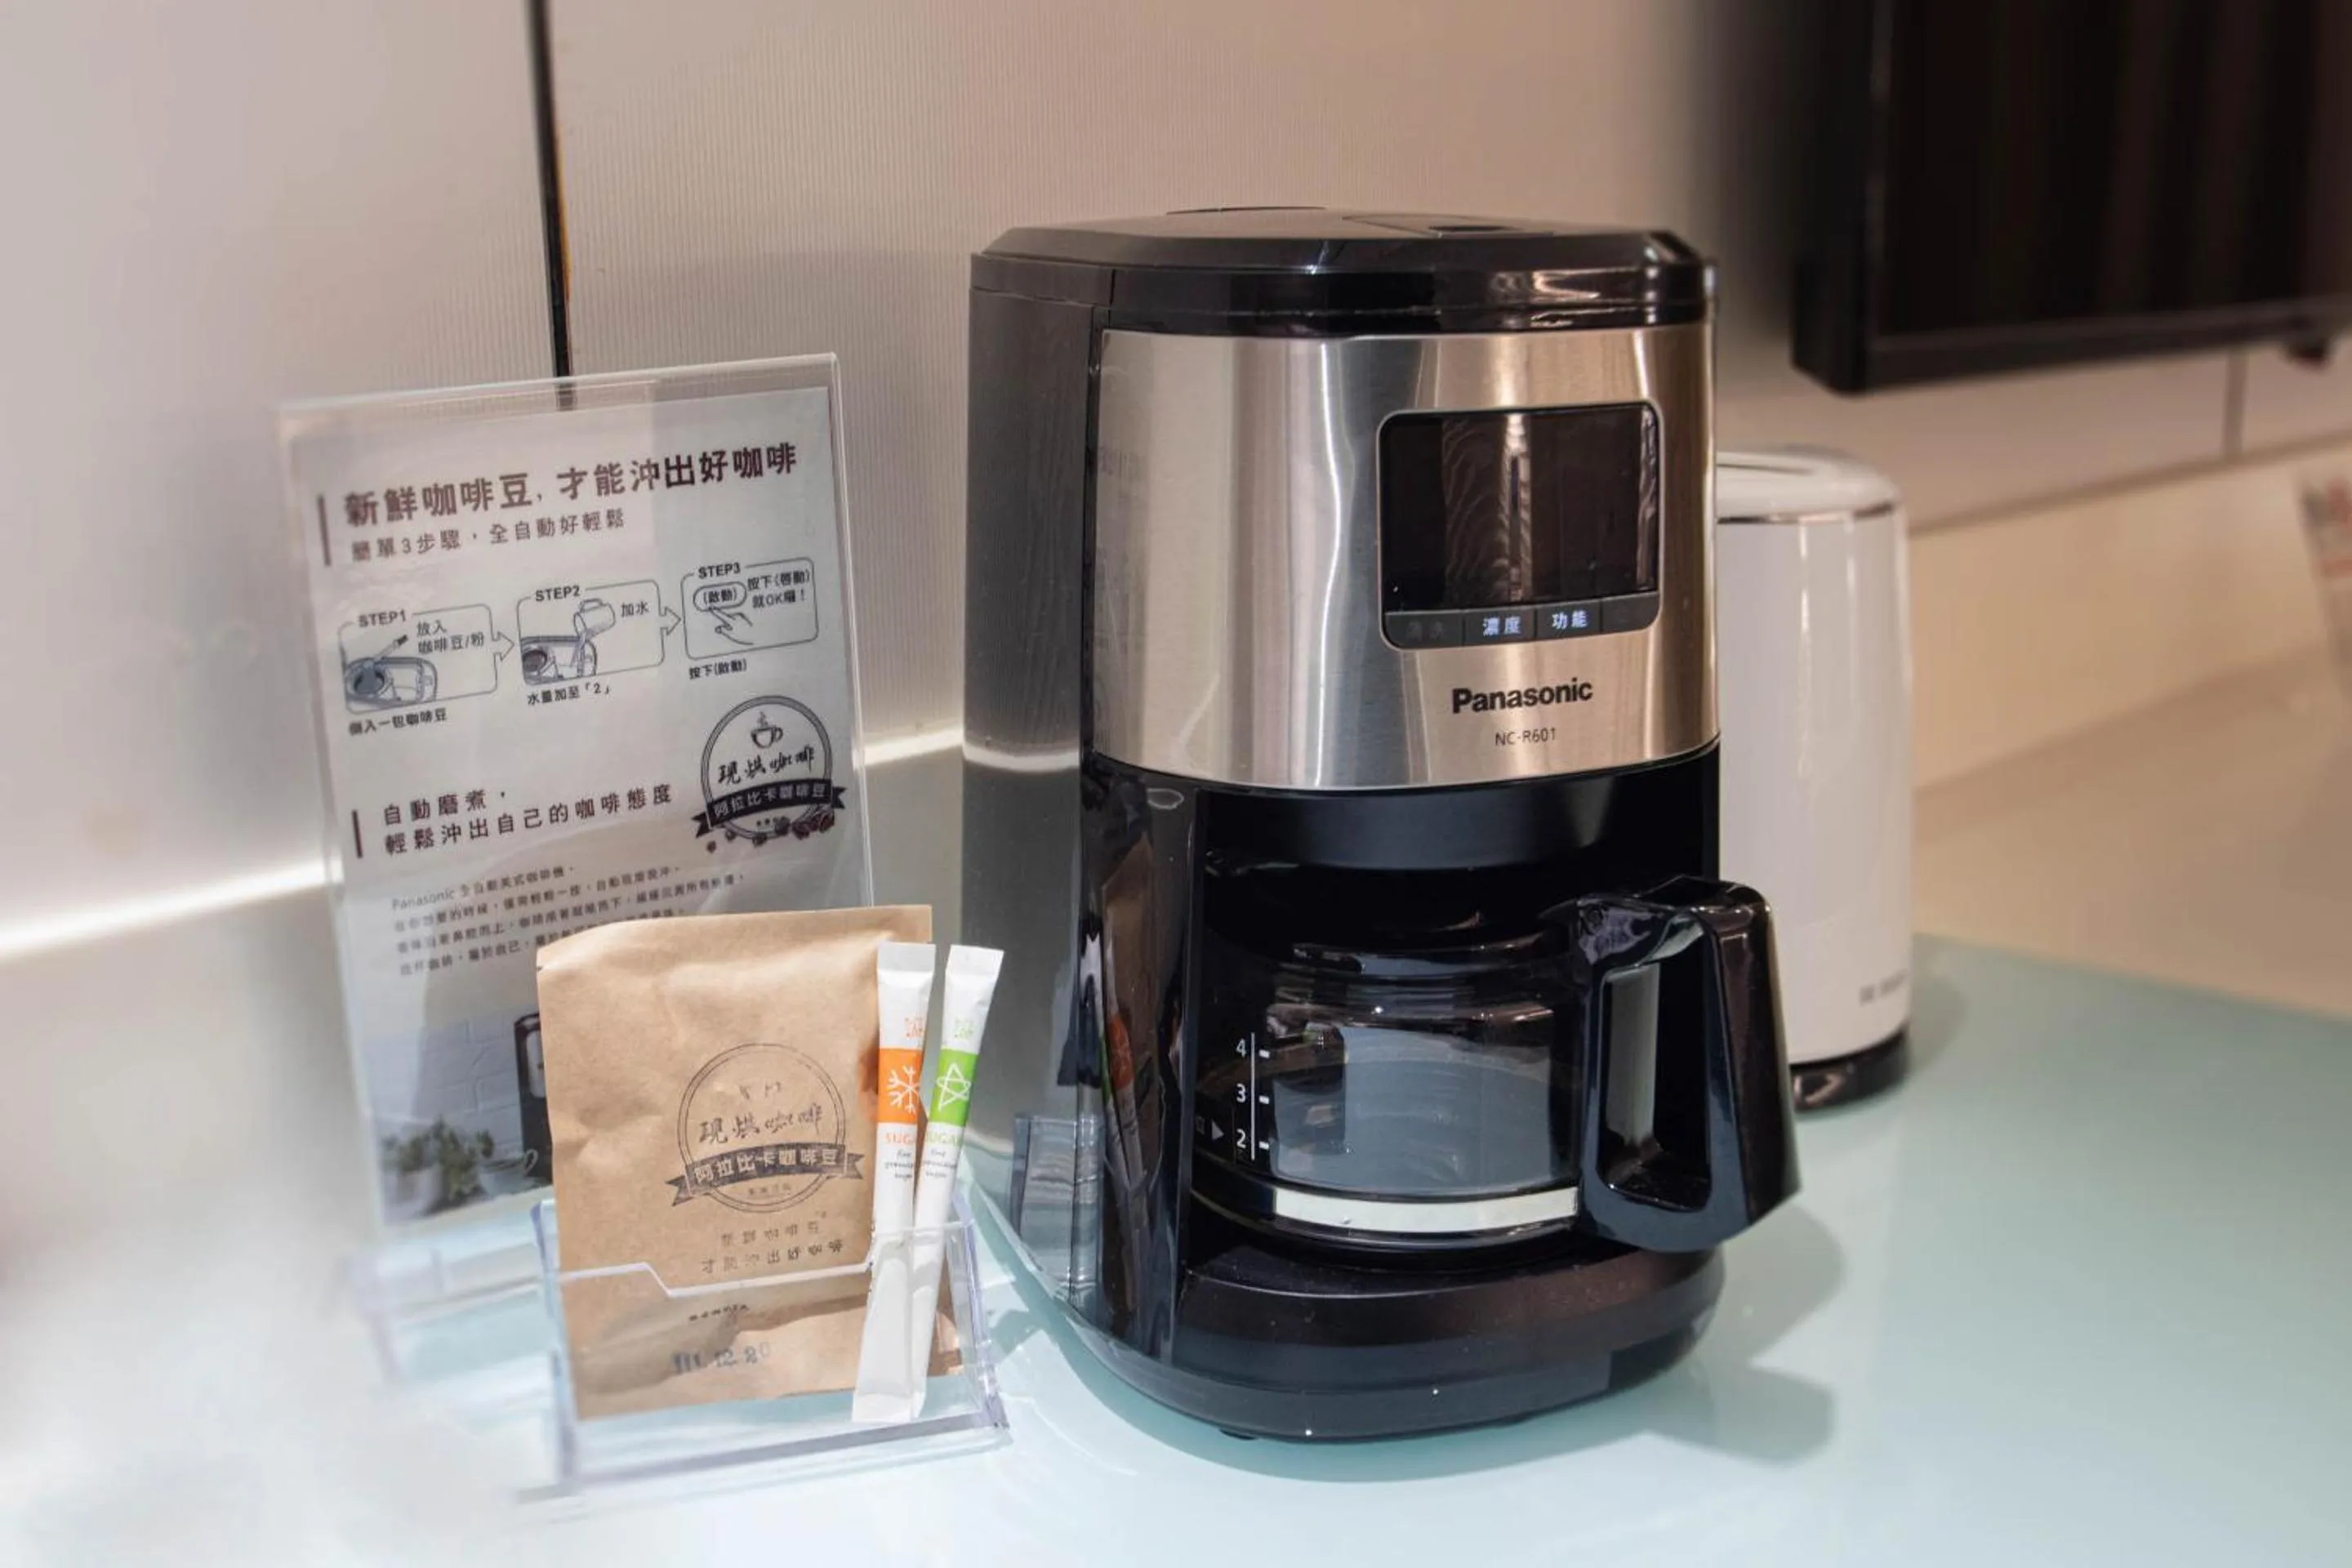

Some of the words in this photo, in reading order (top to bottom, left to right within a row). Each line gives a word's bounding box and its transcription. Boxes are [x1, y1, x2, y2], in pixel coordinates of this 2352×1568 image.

[698, 563, 741, 579] STEP3
[535, 585, 581, 602] STEP2
[358, 609, 406, 627] STEP1
[621, 601, 649, 617] 加水
[416, 620, 447, 636] 放入
[1482, 617, 1522, 636] 濃度
[1552, 609, 1588, 630] 功能
[417, 631, 485, 654] 咖啡豆/粉
[1452, 677, 1592, 714] Panasonic
[1494, 727, 1557, 746] NC-R601
[385, 784, 673, 855] 輕鬆沖出自己的咖啡態度
[391, 889, 455, 911] Panasonic
[1236, 1038, 1246, 1058] 4
[1236, 1083, 1246, 1102] 3
[1236, 1129, 1246, 1149] 2
[694, 1148, 839, 1183] 阿拉比卡咖啡豆
